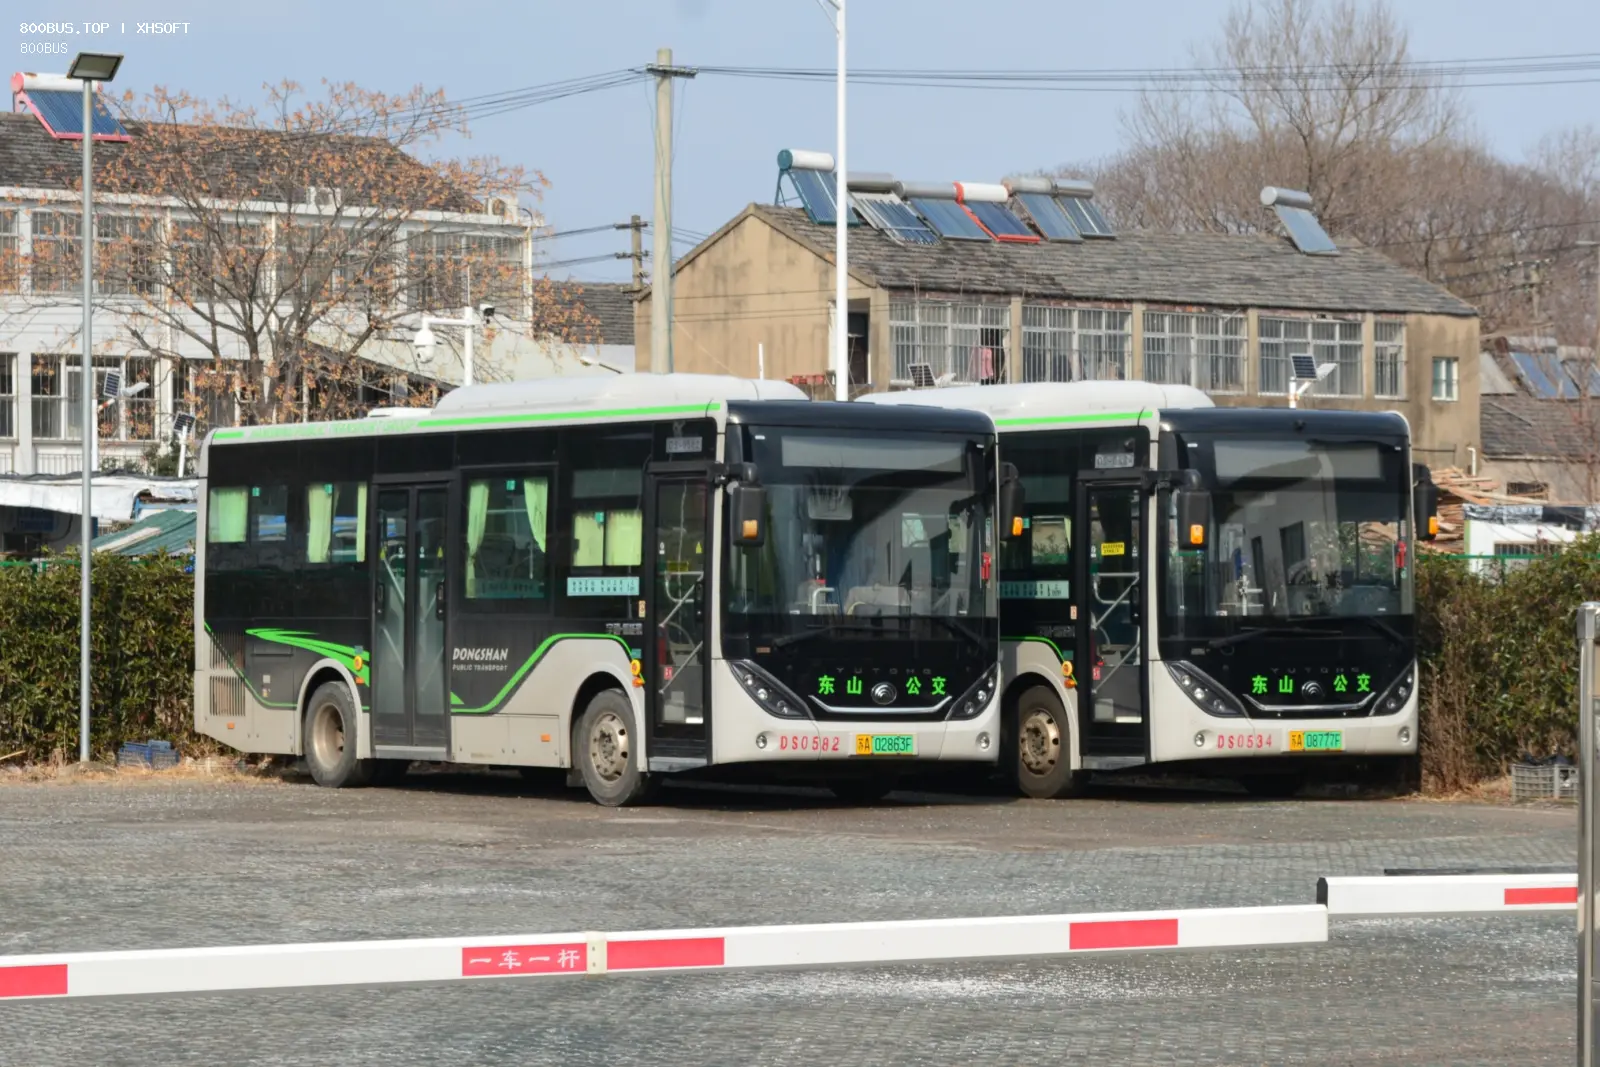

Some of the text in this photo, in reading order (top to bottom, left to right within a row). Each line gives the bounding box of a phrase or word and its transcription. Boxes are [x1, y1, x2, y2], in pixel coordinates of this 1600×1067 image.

[452, 647, 509, 661] DONGSHAN
[780, 735, 840, 751] DS0582
[469, 949, 580, 970] 一车一杆
